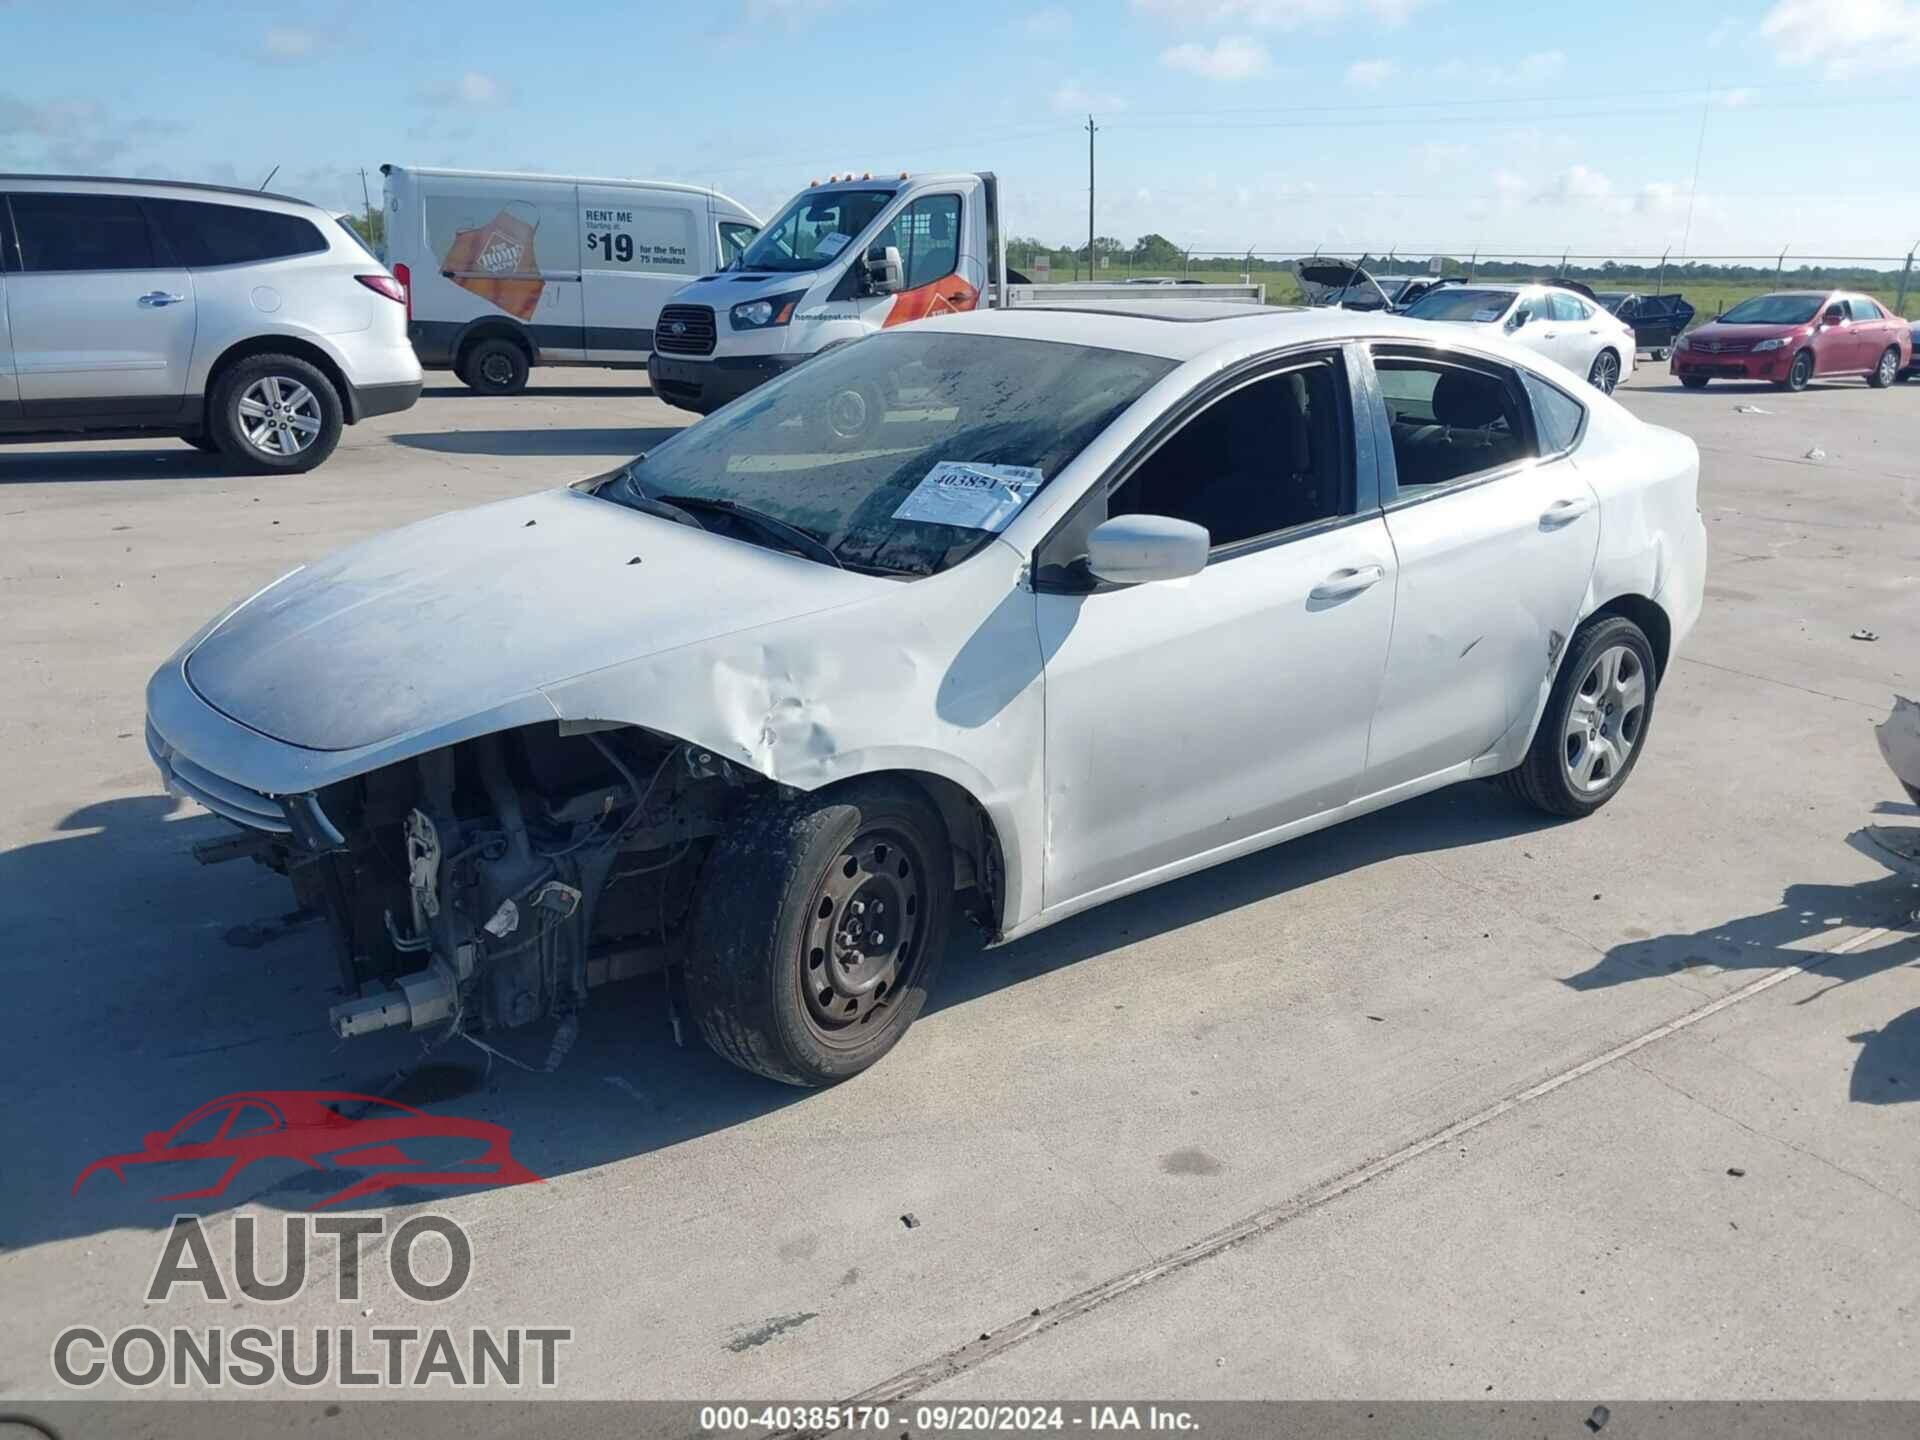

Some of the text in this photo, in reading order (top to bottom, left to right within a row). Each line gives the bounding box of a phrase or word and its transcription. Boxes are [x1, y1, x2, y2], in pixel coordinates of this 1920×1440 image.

[586, 210, 633, 223] RENT ME
[587, 232, 634, 262] $19
[640, 246, 686, 255] for the first
[640, 255, 686, 265] 75 minutes
